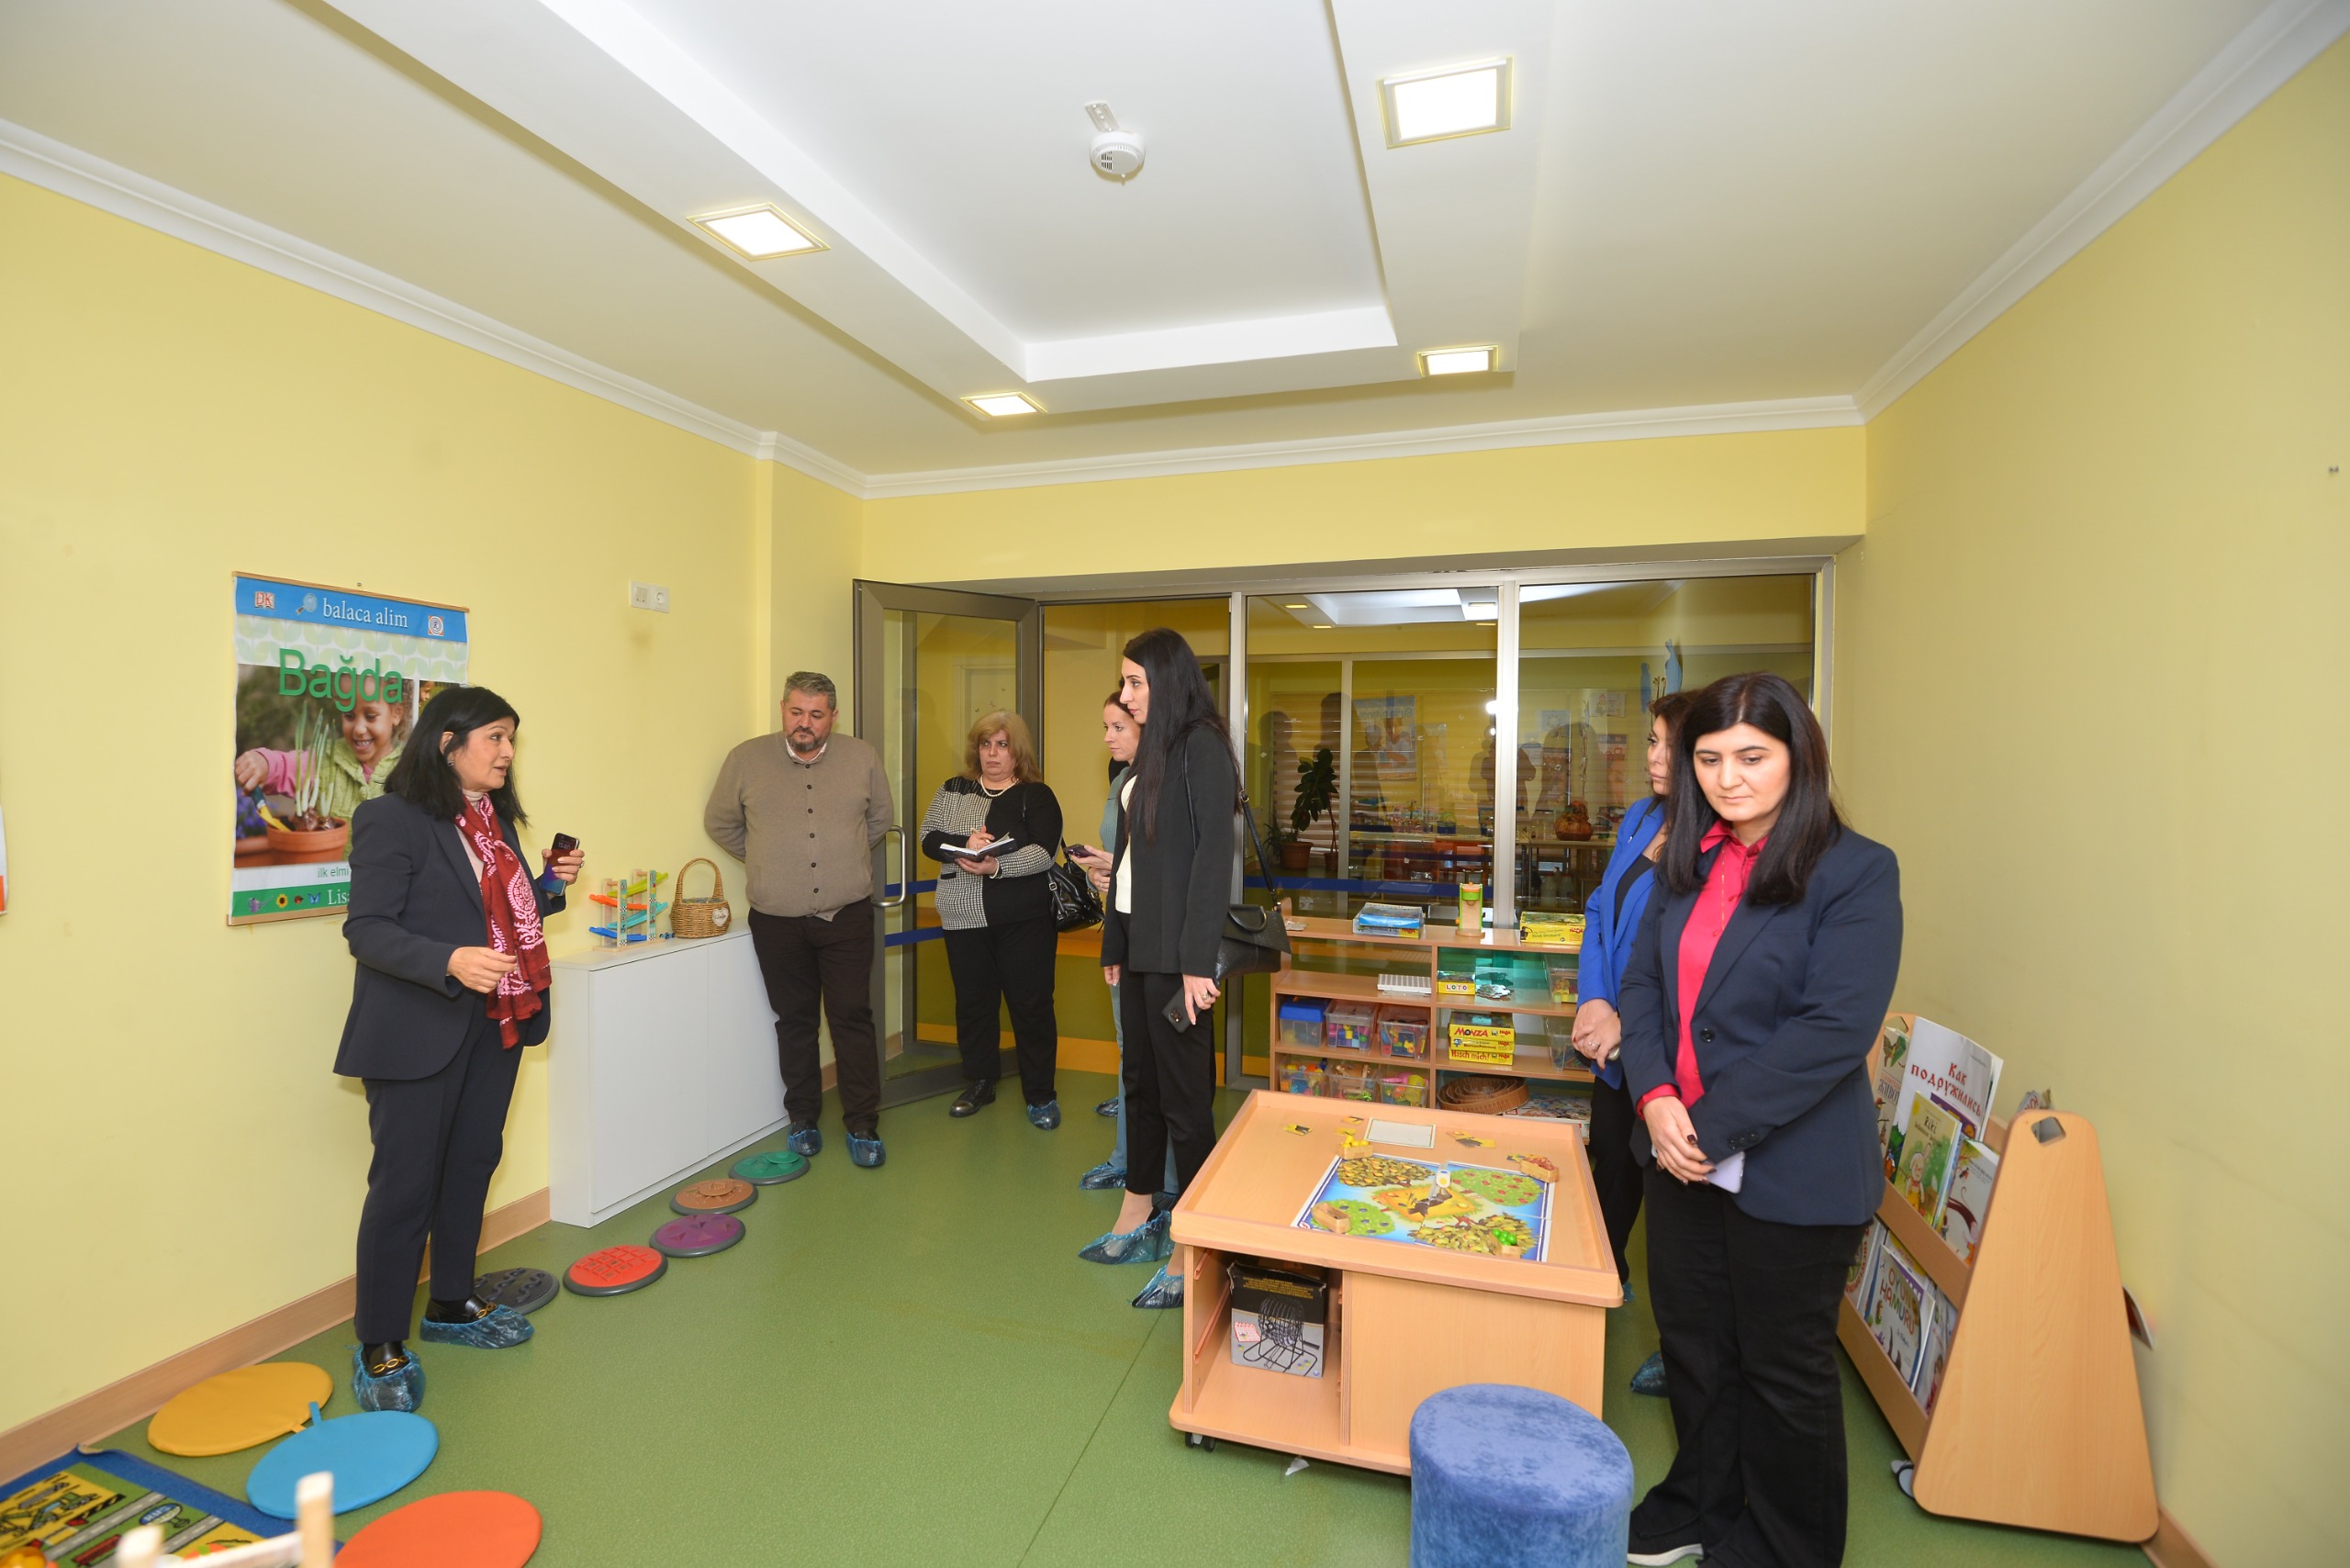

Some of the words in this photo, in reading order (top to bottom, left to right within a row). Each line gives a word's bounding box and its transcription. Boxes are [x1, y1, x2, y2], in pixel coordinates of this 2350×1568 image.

[255, 592, 274, 608] DK
[323, 598, 371, 623] balaca
[376, 607, 408, 628] alim
[279, 647, 403, 712] Bağda
[318, 868, 328, 878] ilk
[330, 867, 349, 877] elmi
[1454, 1026, 1488, 1037] MONZA
[1451, 1049, 1470, 1058] Hasch
[1471, 1052, 1490, 1061] mich!
[1949, 1062, 1968, 1085] Как
[1879, 1279, 1915, 1336] HAMURU
